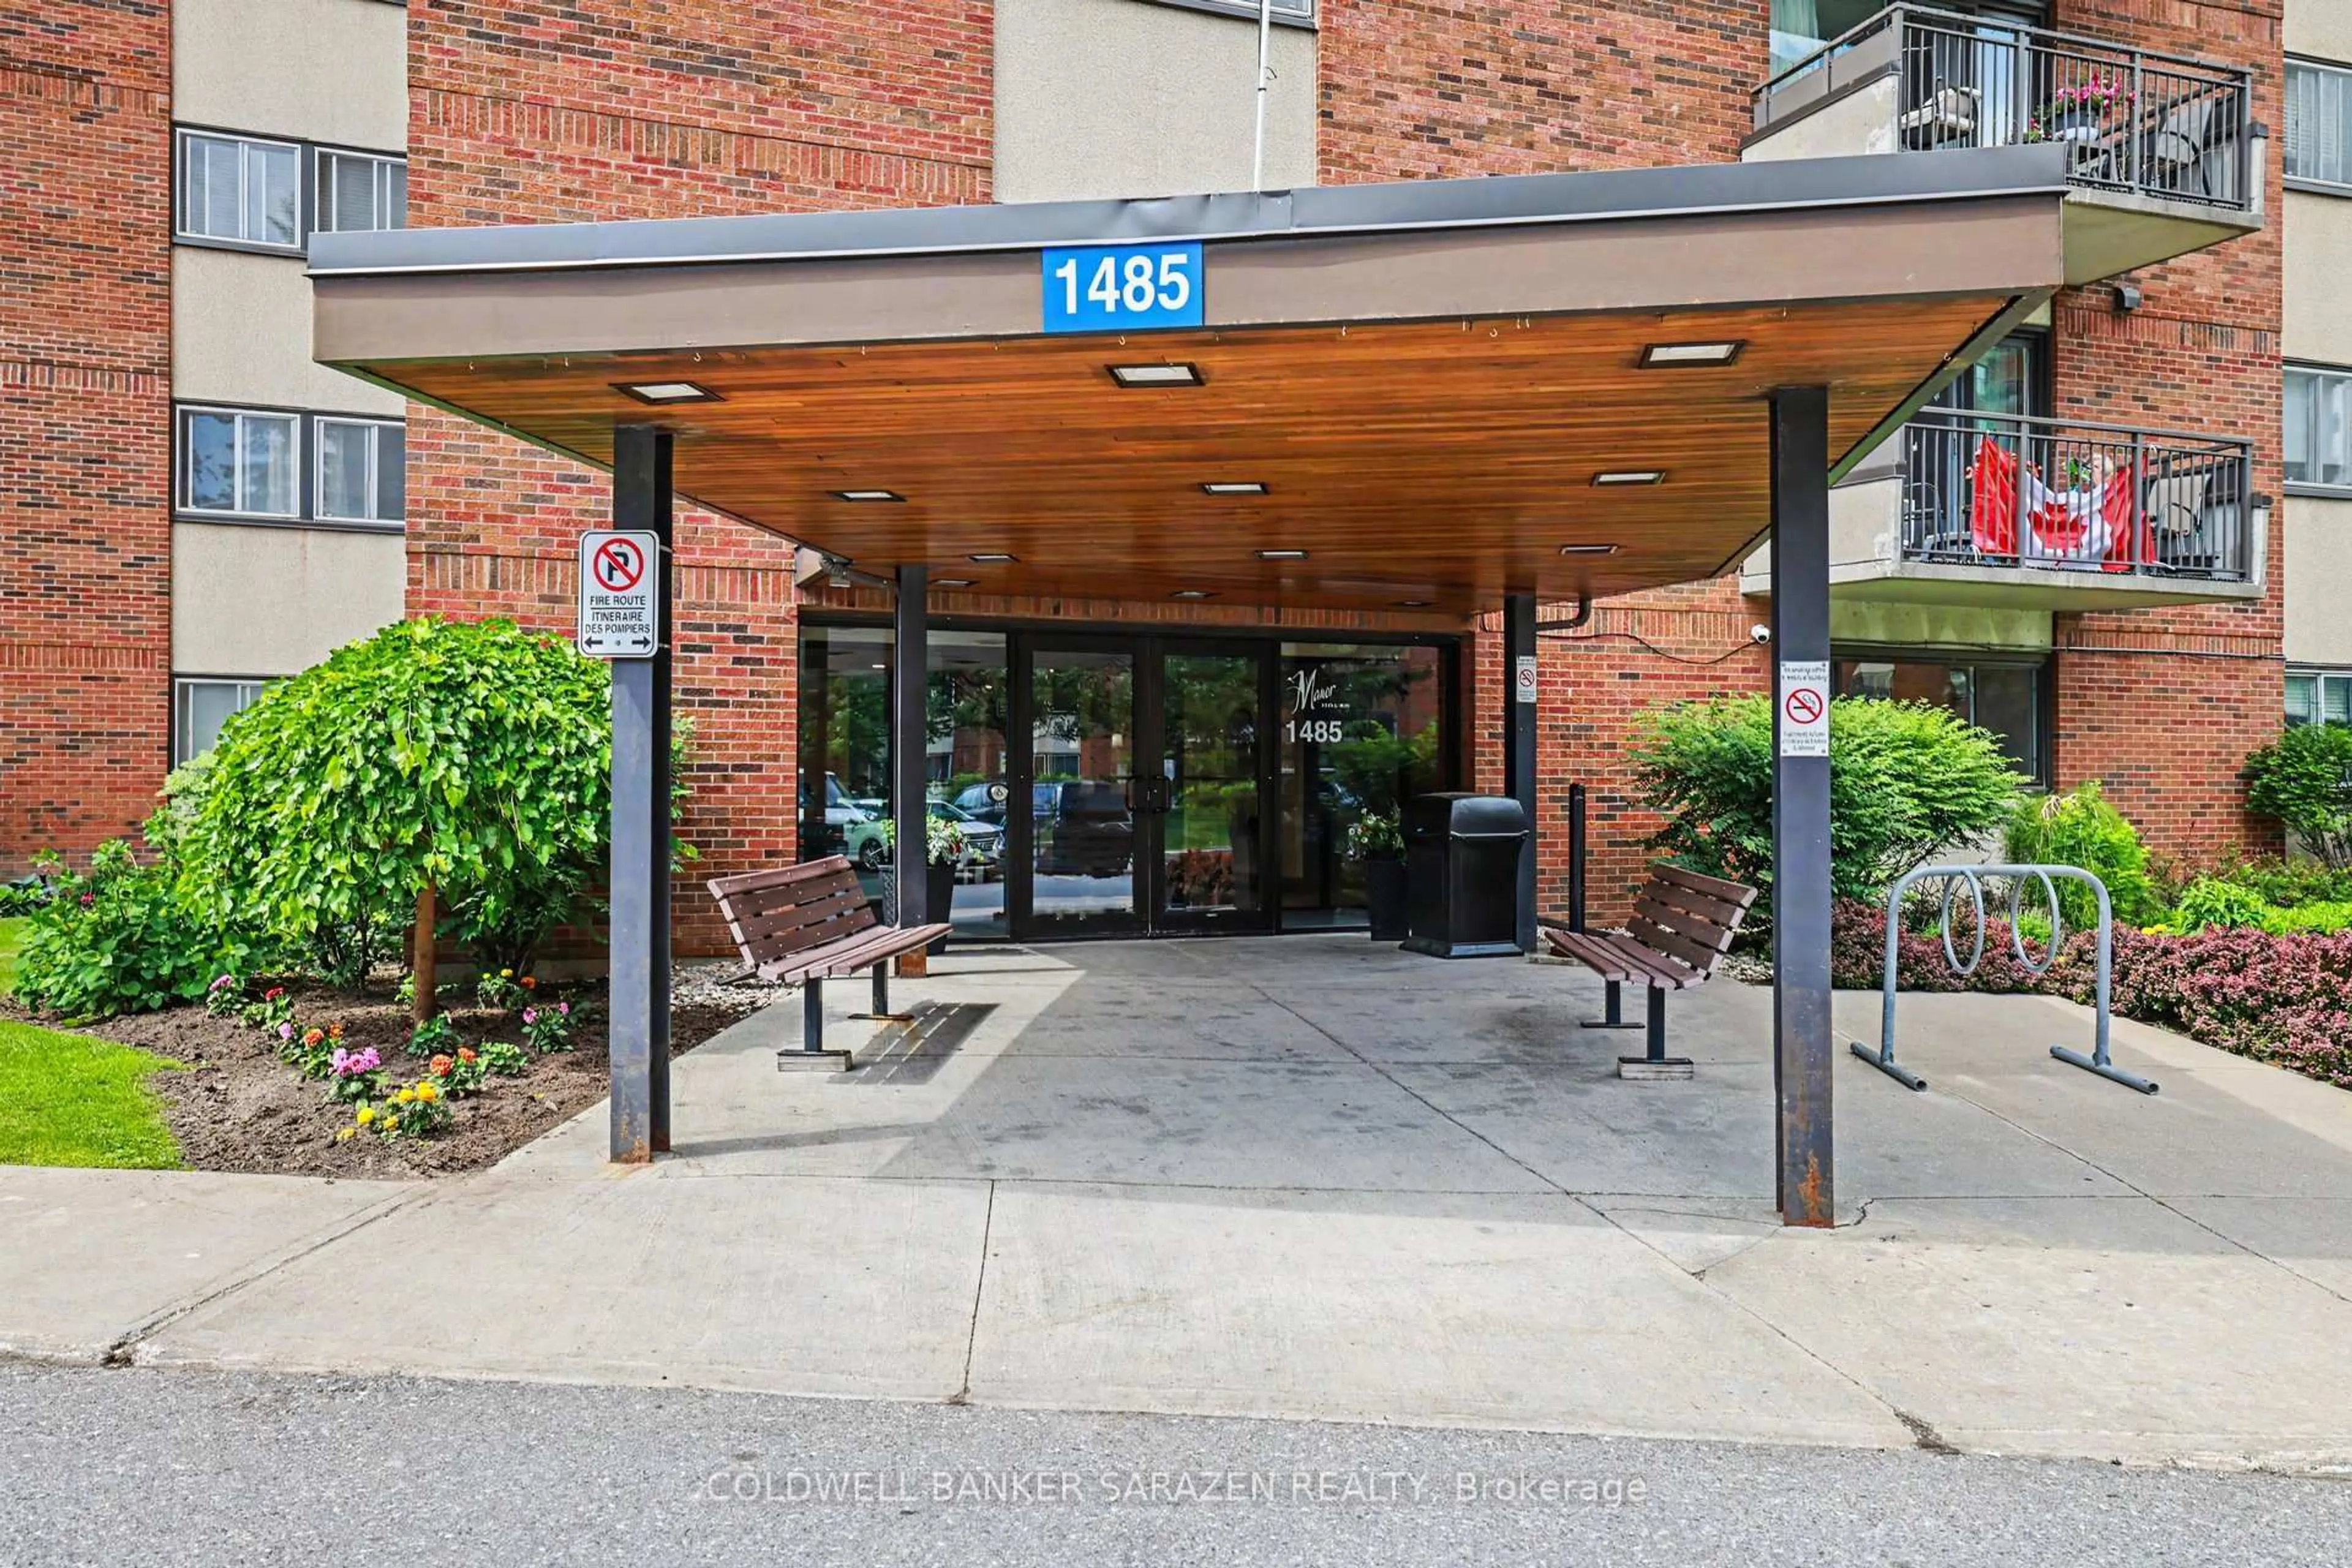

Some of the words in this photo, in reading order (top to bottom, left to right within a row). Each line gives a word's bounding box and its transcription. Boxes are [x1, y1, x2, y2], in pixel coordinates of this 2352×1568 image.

[1055, 254, 1189, 314] 1485
[590, 595, 610, 605] FIRE
[613, 595, 646, 605] ROUTE
[592, 611, 643, 621] ITINERAIRE
[585, 624, 603, 633] DES
[605, 624, 650, 633] POMPIERS
[1286, 668, 1336, 714] Manor
[1286, 720, 1342, 742] 1485
